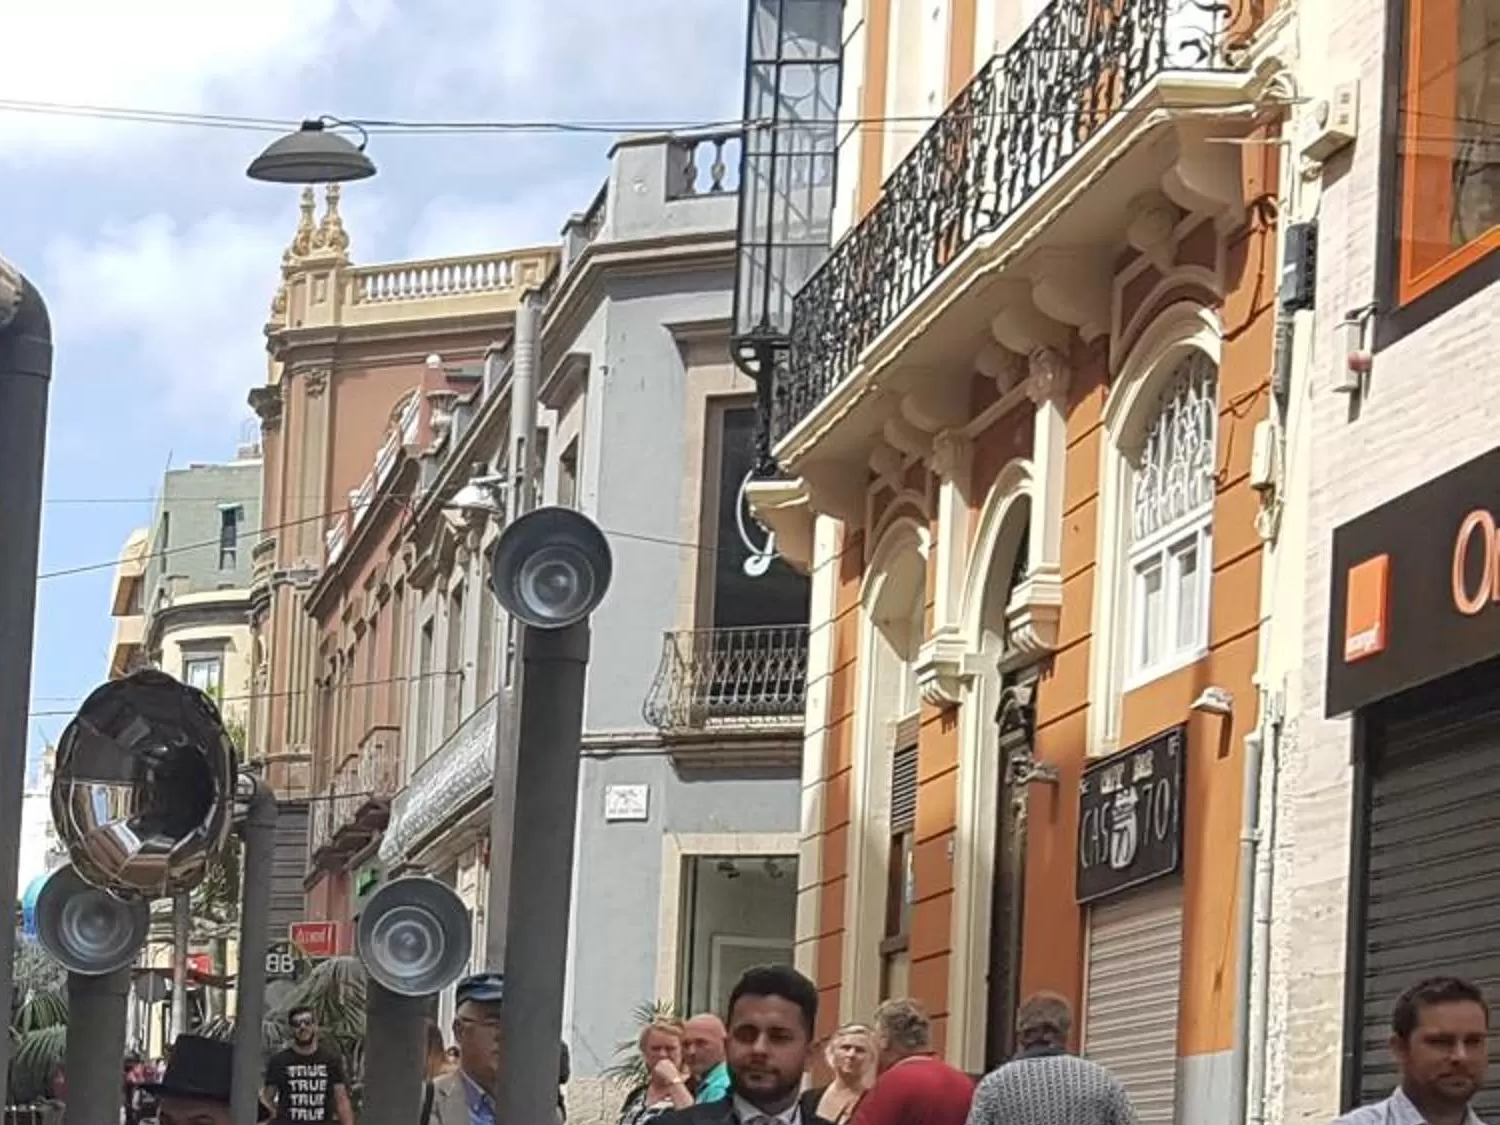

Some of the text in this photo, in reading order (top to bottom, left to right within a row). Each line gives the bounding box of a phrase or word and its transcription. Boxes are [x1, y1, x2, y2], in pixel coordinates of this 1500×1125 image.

[287, 1064, 328, 1078] TRUE
[288, 1079, 328, 1092] TRUE
[290, 1093, 326, 1106] TRUE
[290, 1107, 325, 1121] TRUE
